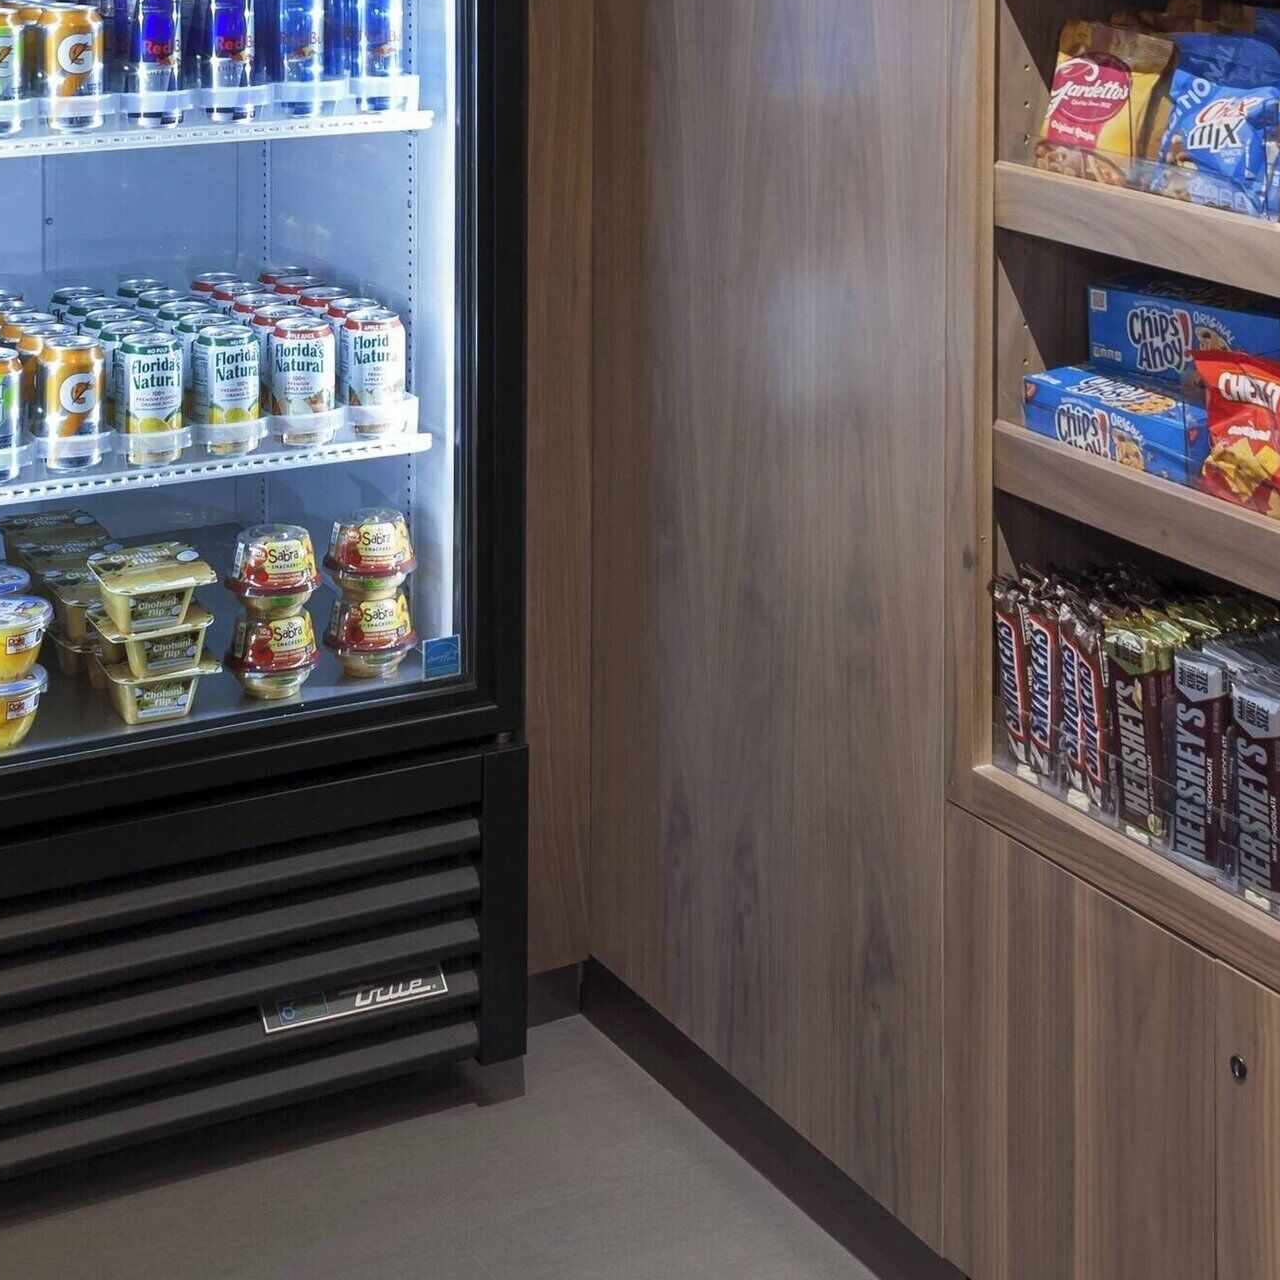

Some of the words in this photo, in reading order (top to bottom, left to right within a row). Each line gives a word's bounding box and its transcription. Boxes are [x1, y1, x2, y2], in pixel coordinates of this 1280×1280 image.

[143, 40, 171, 55] Red
[1051, 122, 1075, 135] Original
[1075, 128, 1095, 141] Recipe
[1127, 308, 1180, 346] Chips
[1193, 312, 1235, 345] ORIGINAL
[275, 344, 324, 359] Florida's
[132, 358, 180, 374] Florida's
[275, 358, 324, 373] Natural
[1056, 405, 1099, 443] Chips
[362, 532, 391, 546] Sabra
[110, 548, 171, 563] Chobani
[268, 549, 299, 563] Sabra
[138, 597, 177, 610] Chobani
[148, 608, 165, 617] flip
[363, 607, 394, 622] Sabra
[273, 628, 302, 642] Sabra
[153, 639, 192, 652] Chobani
[163, 649, 180, 659] flip
[1029, 626, 1050, 743] SNICKERS
[144, 687, 184, 700] Chobani
[154, 696, 171, 707] flip
[1257, 705, 1269, 732] SIZE
[1116, 680, 1149, 817] HERSHEY'S
[1176, 701, 1206, 862] HERSHEY'S
[1236, 736, 1270, 891] HERSHEY'S
